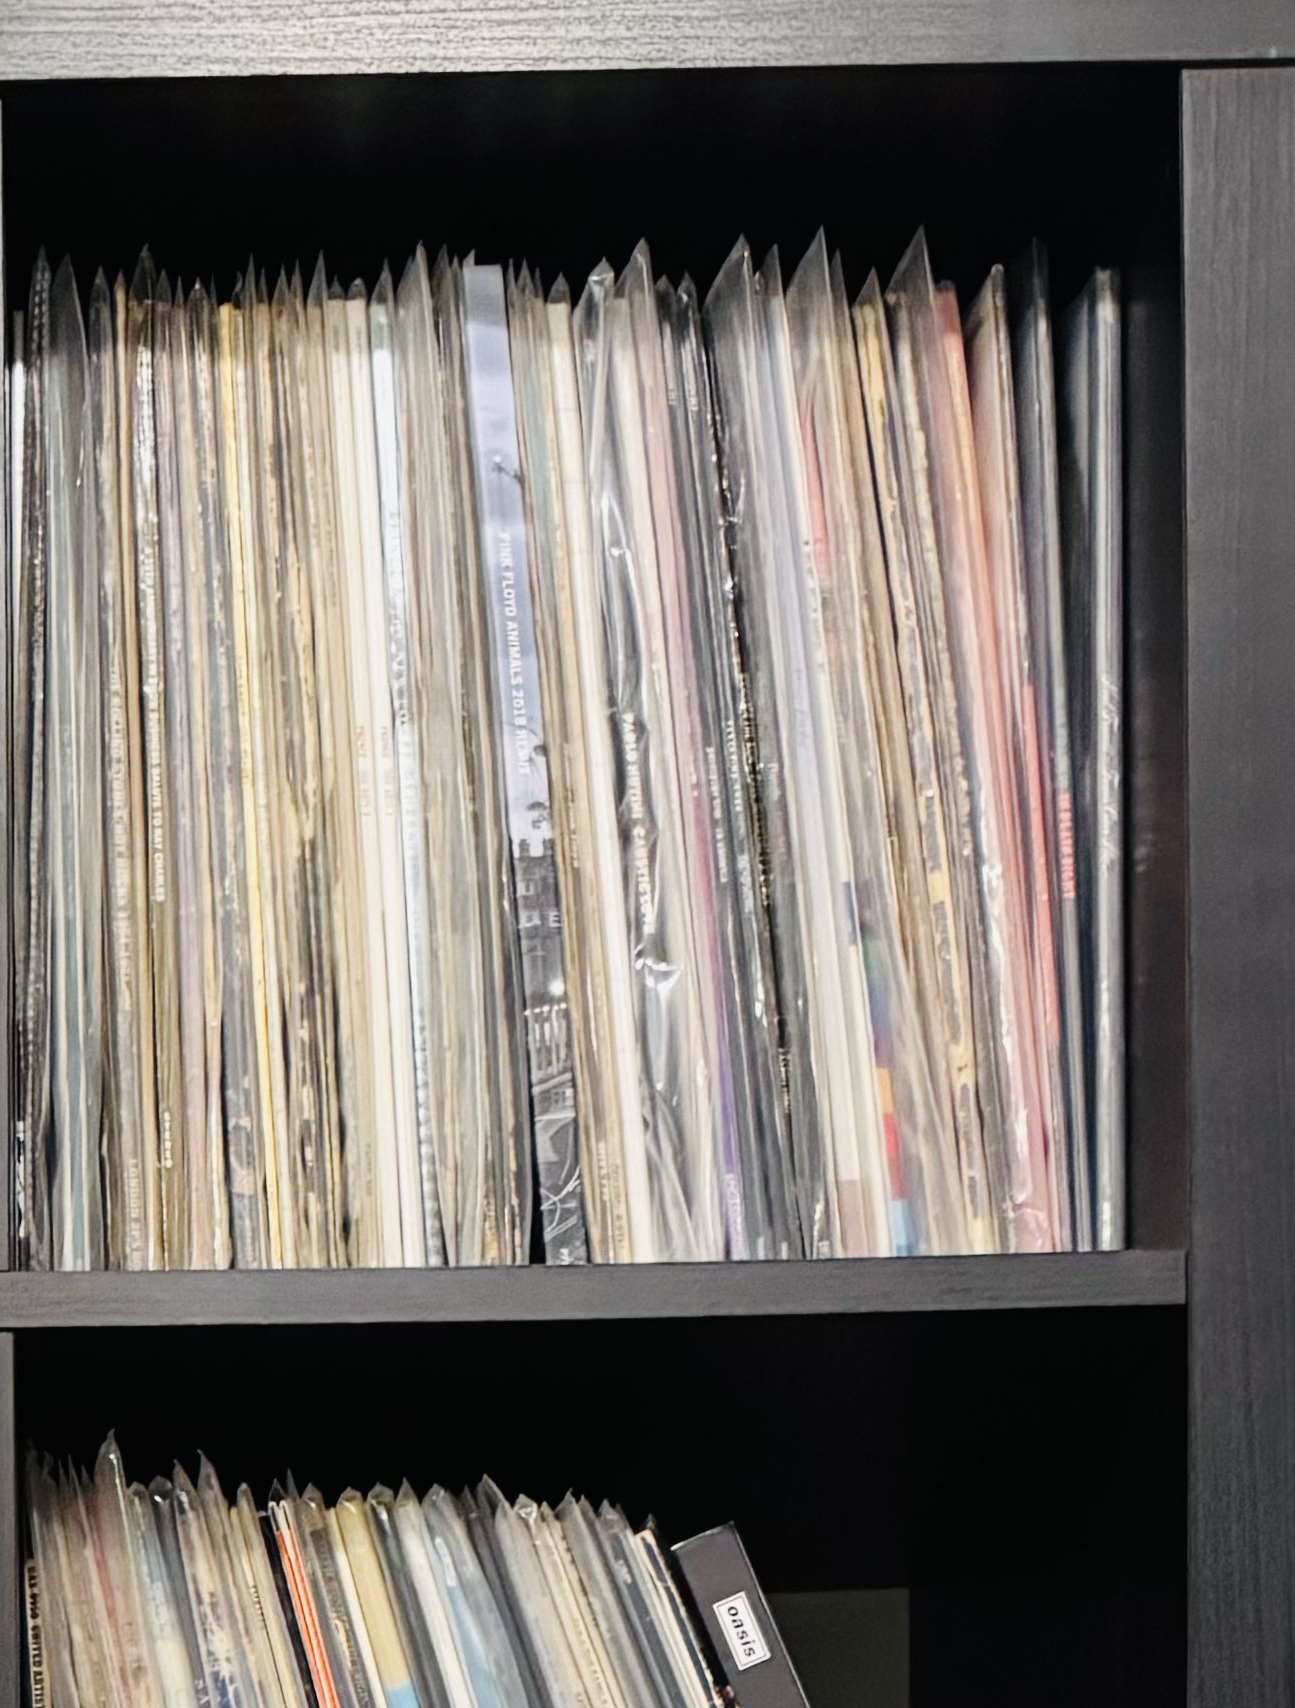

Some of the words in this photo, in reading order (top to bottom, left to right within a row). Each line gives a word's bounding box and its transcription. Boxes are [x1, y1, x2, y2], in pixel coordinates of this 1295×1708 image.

[499, 532, 512, 567] PINK
[502, 571, 516, 616] FLOYD
[506, 621, 522, 684] ANIMALS
[512, 689, 525, 725] 2018
[623, 713, 638, 762] PAOLO
[129, 1159, 141, 1218] LONDON
[30, 1625, 43, 1667] UNITED
[725, 1602, 760, 1660] oasis
